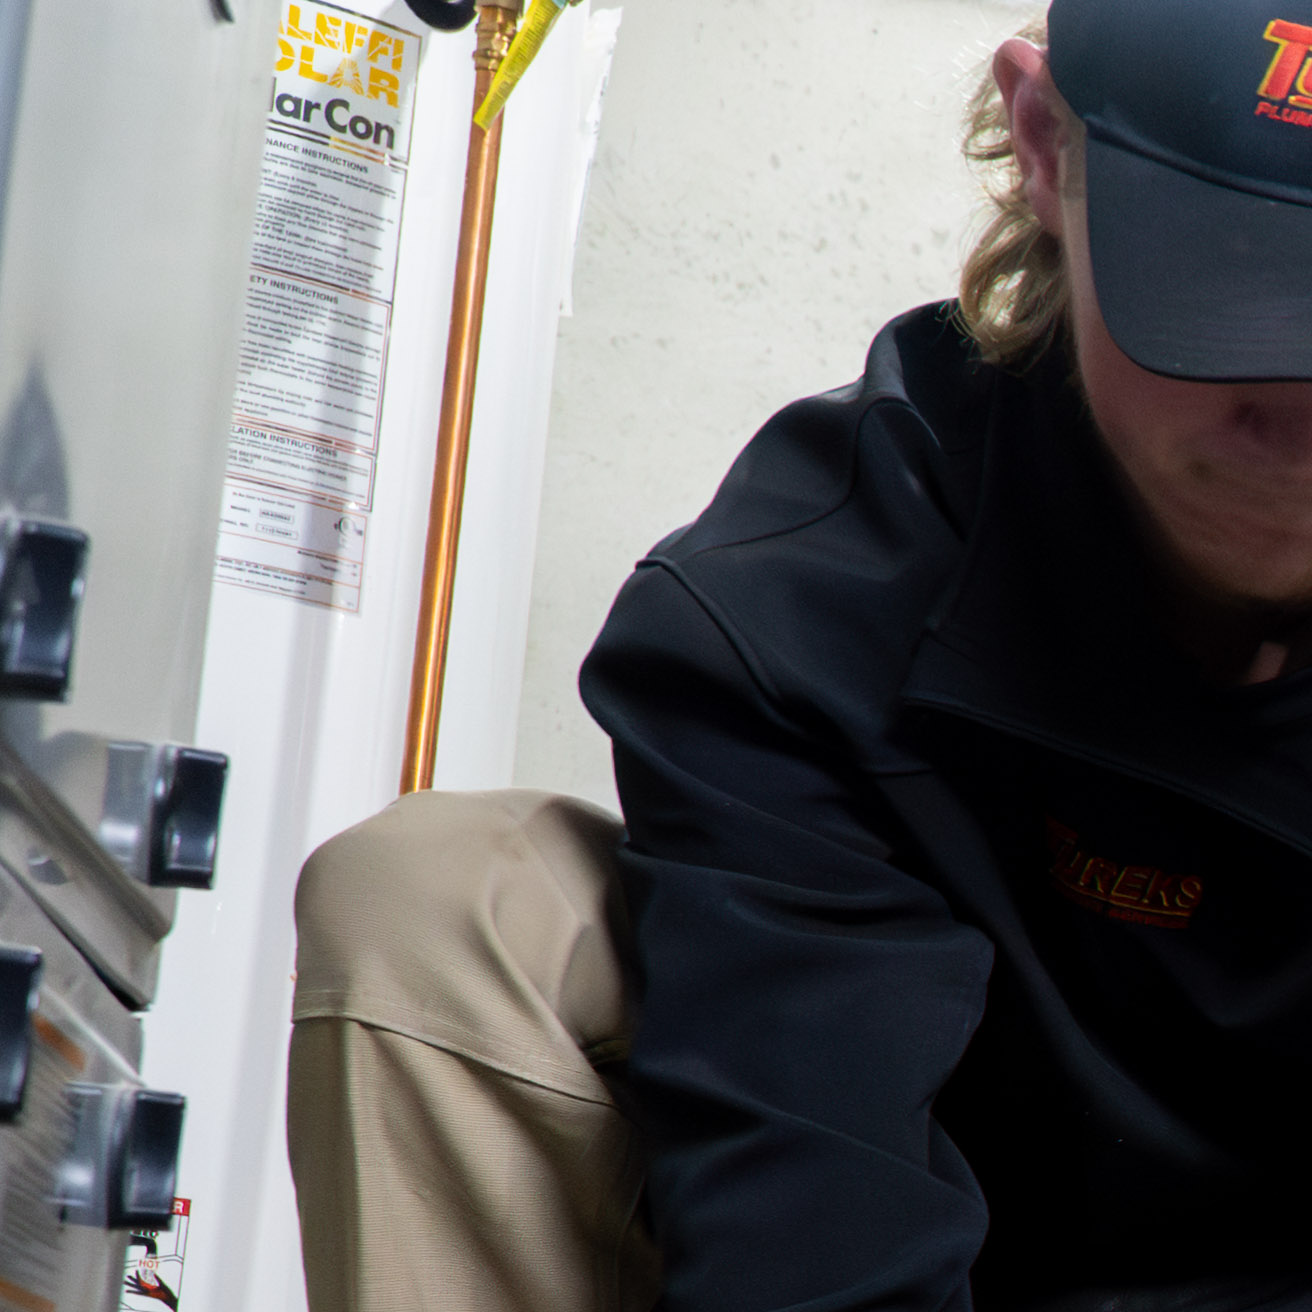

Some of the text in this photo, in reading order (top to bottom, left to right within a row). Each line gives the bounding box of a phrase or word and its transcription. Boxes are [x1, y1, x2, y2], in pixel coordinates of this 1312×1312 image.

[278, 4, 405, 72] LEFFI
[301, 145, 369, 174] INSTRUCTIONS
[269, 279, 339, 304] INSTRUCTIONS
[269, 432, 338, 457] INSTRUCTIONS
[138, 1259, 160, 1269] HOT
